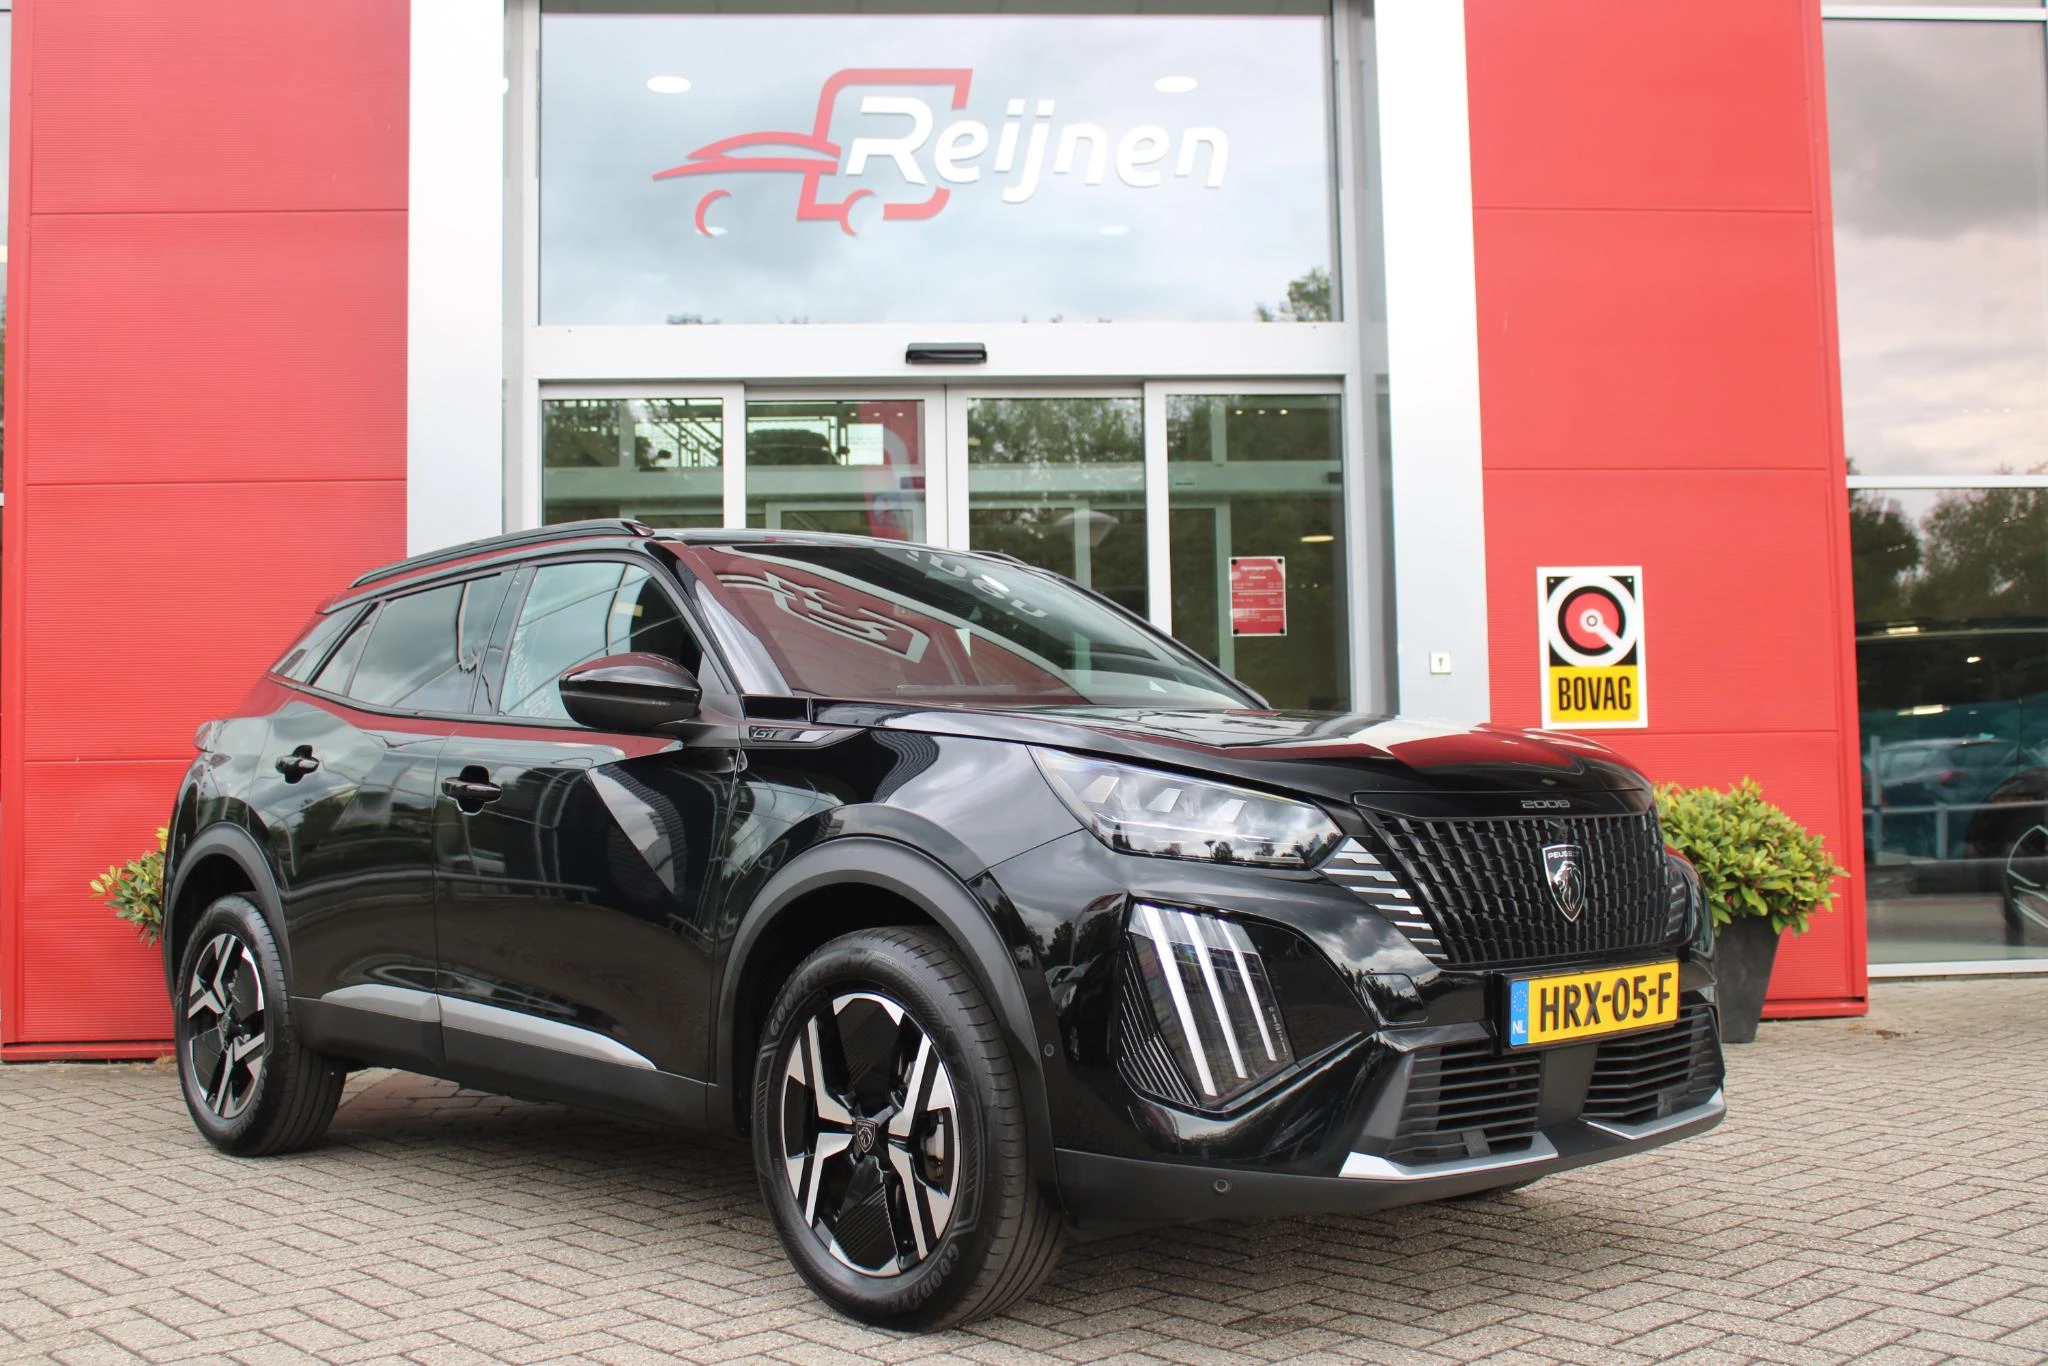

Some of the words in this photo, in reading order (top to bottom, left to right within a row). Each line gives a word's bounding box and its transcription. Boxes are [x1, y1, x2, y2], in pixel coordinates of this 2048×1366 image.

[845, 96, 1230, 203] Reijnen
[1558, 676, 1631, 711] BOVAG
[753, 729, 783, 738] GT
[1521, 799, 1570, 808] 2008
[1547, 850, 1579, 859] PEUGE
[1540, 972, 1672, 1032] HRX-05-F
[1512, 1020, 1526, 1035] NL
